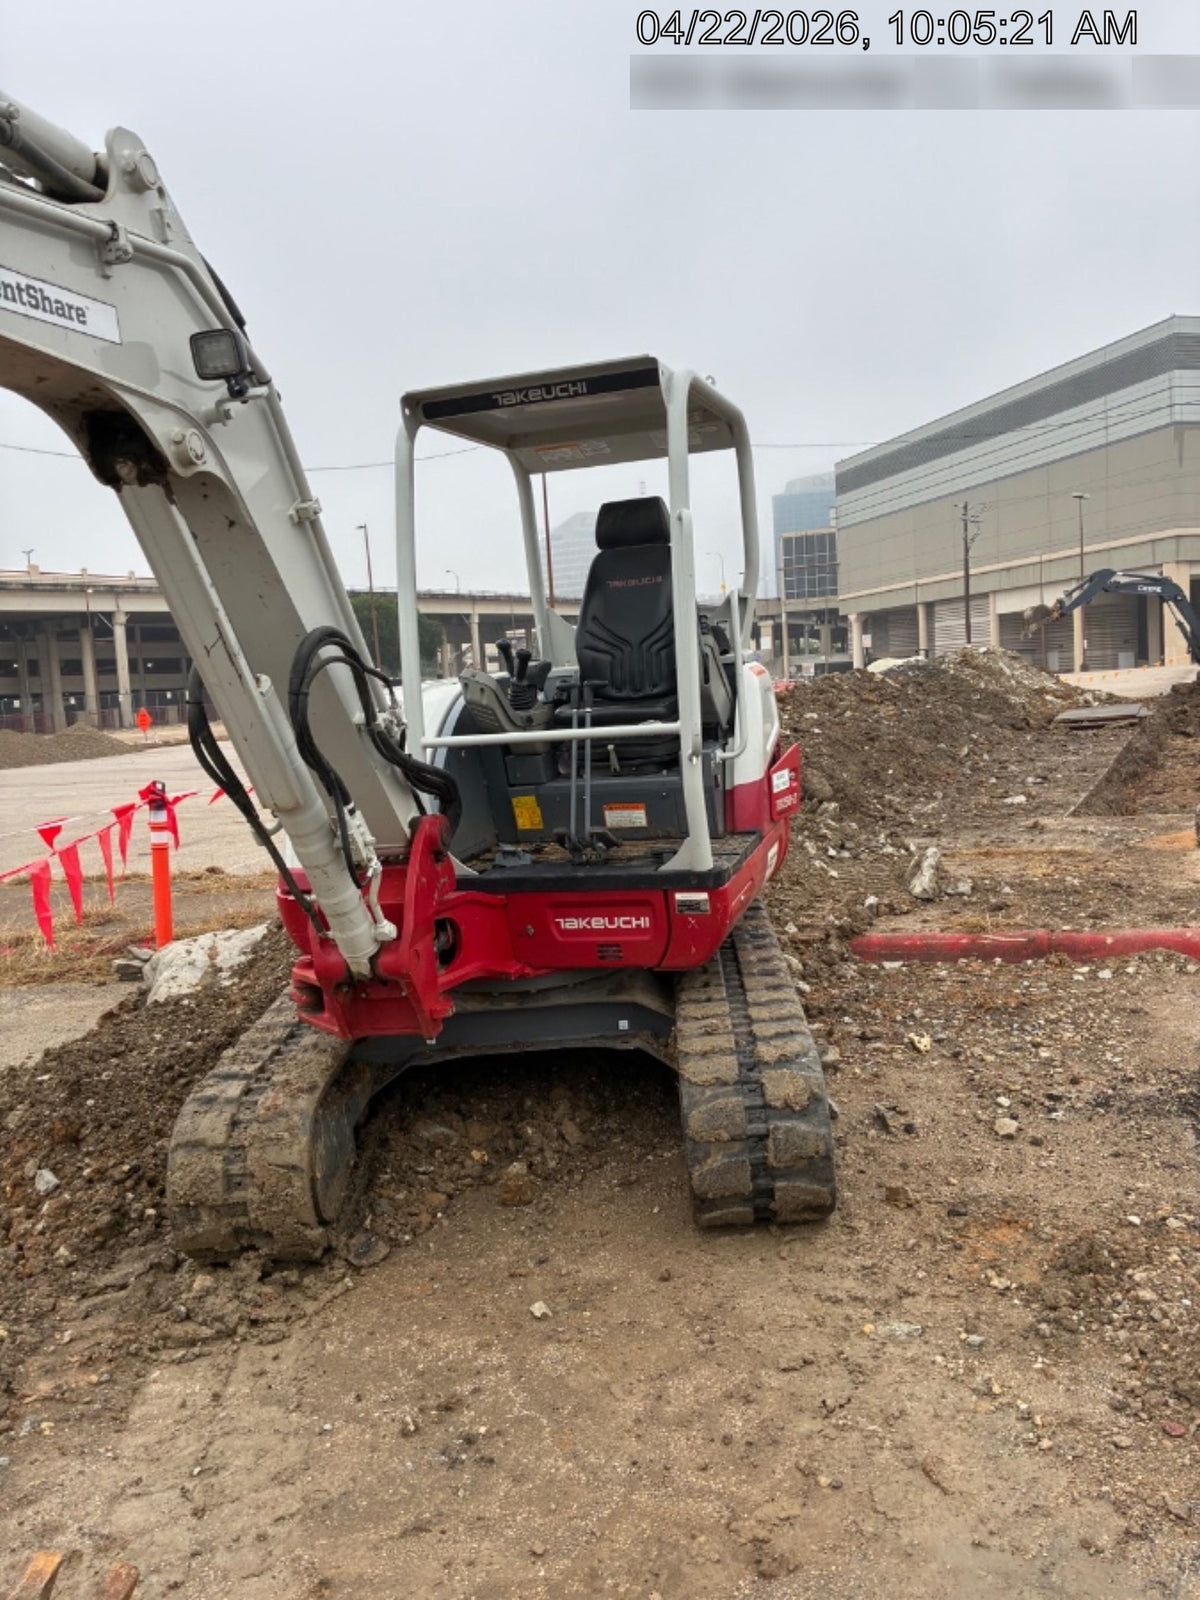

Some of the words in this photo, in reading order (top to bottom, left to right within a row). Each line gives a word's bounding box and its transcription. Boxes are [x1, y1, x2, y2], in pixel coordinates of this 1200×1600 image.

[0, 281, 87, 326] ntShare
[492, 381, 587, 406] TAKEUCHI
[554, 916, 649, 930] TAKEUCHI
